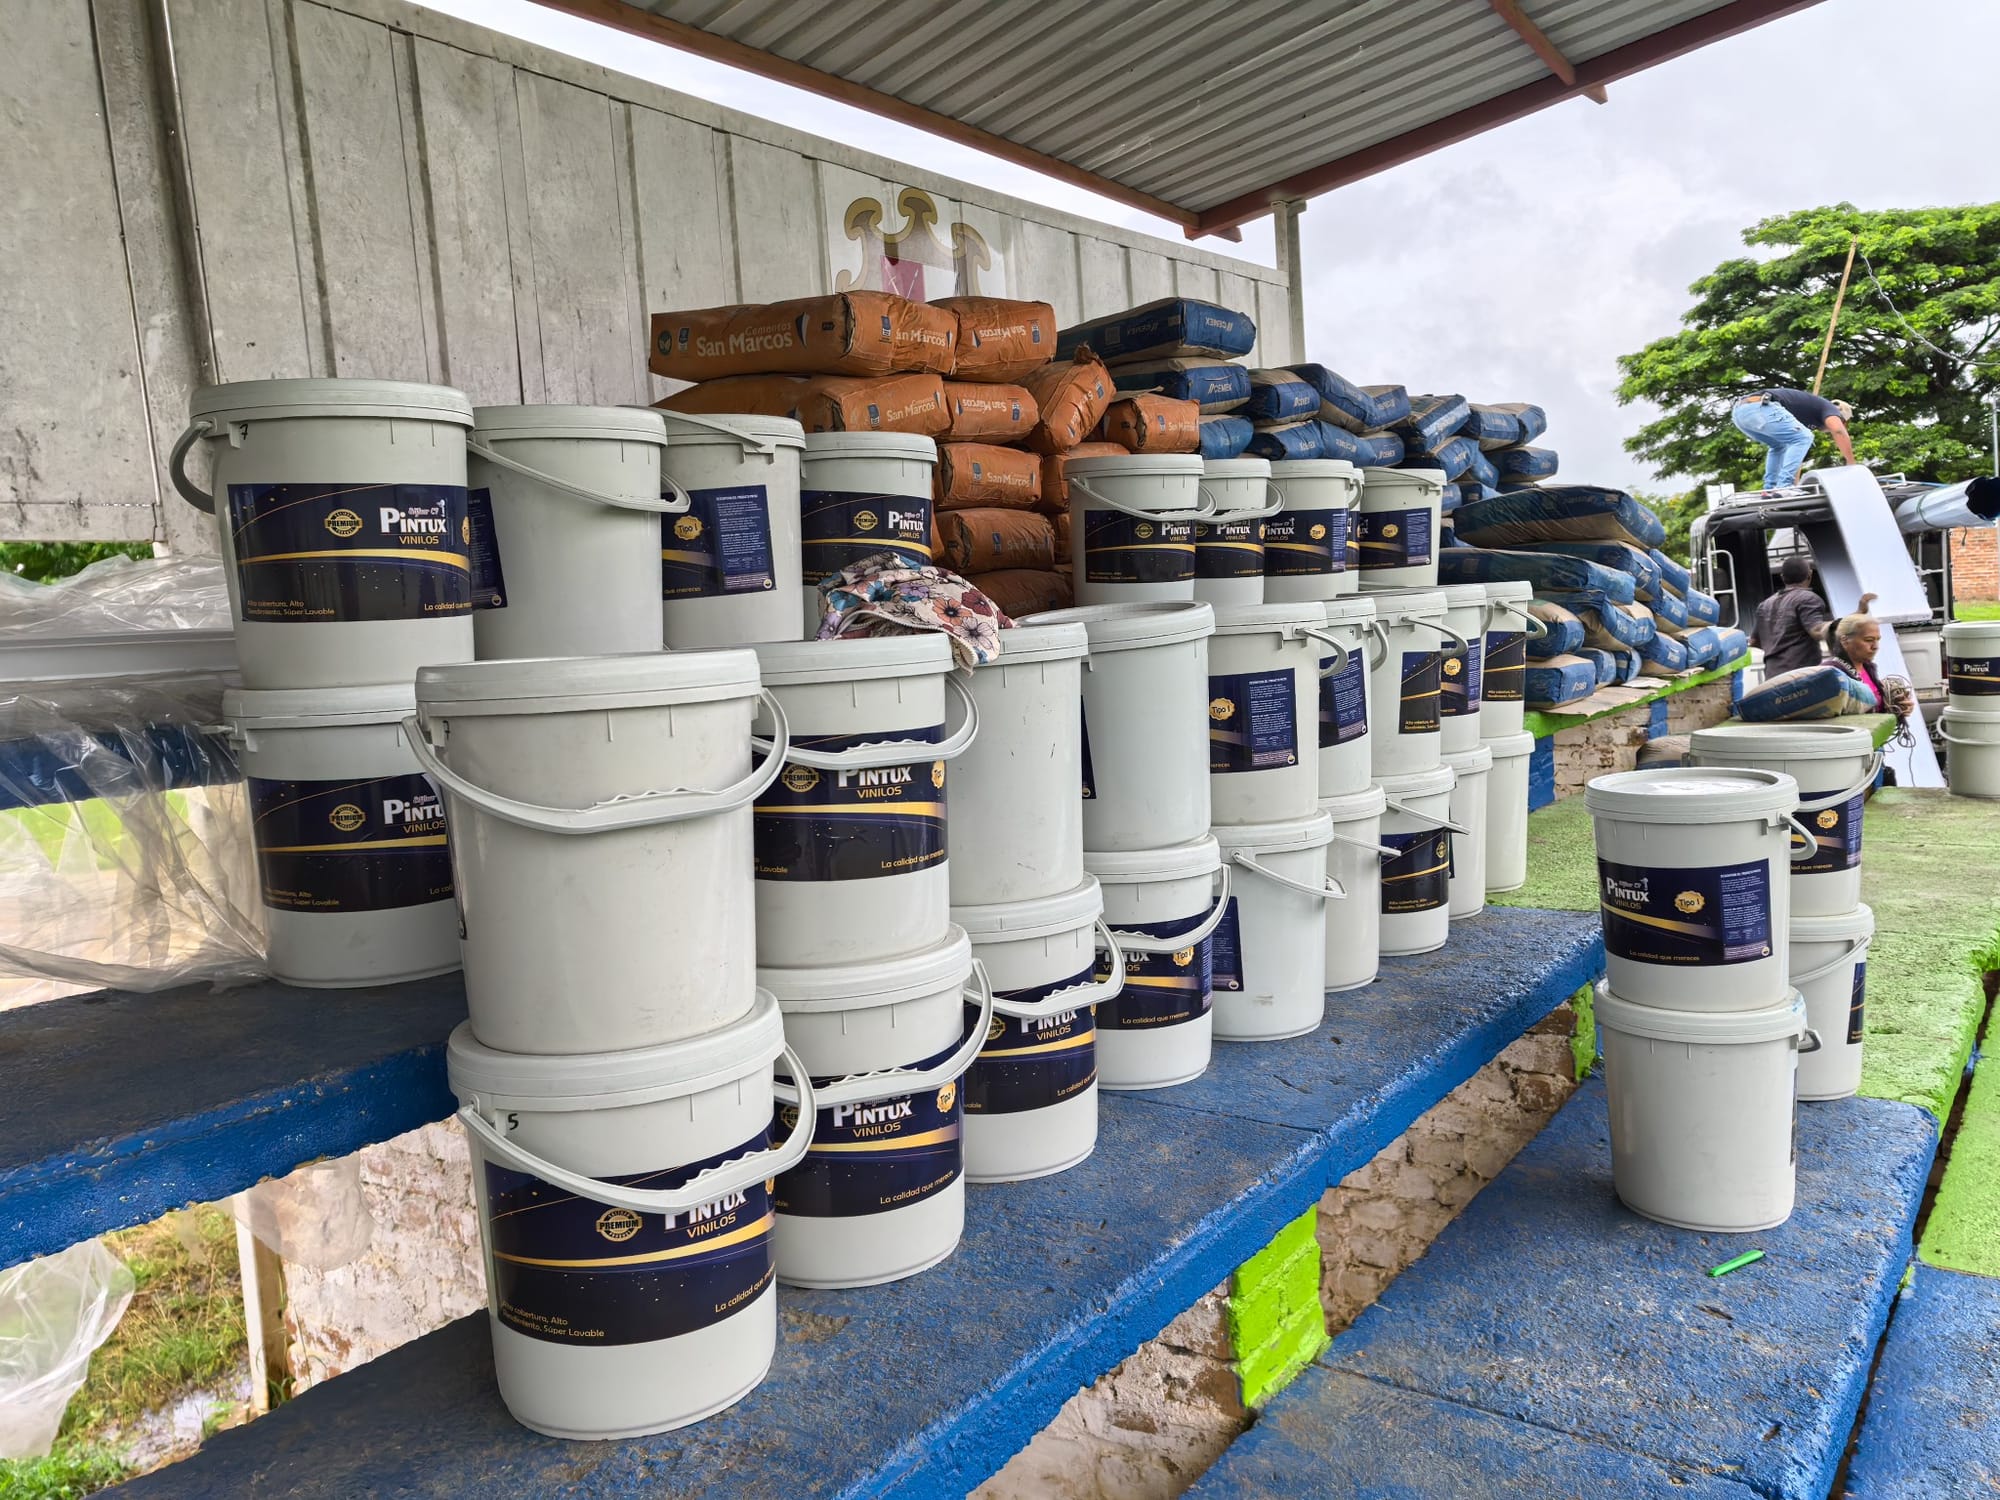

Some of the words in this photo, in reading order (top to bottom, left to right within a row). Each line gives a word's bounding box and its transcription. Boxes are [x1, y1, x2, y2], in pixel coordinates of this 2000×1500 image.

[745, 322, 792, 335] Cementos
[696, 337, 725, 357] San
[728, 332, 793, 355] Marcos
[910, 329, 946, 347] Marcos
[886, 409, 903, 421] San
[904, 401, 935, 417] Marcos
[240, 423, 248, 440] 7
[987, 472, 1001, 483] San
[399, 535, 439, 545] VINILOS
[424, 603, 433, 611] La
[1212, 706, 1227, 715] Tipo
[784, 774, 817, 782] PREMIUM
[856, 786, 902, 799] VINILOS
[881, 860, 892, 869] La
[893, 856, 918, 867] calidad
[1680, 898, 1695, 907] Tipo
[1036, 1025, 1072, 1041] VINILOS
[507, 1113, 519, 1131] 5
[853, 1121, 901, 1138] VINILOS
[880, 1197, 891, 1205] La
[892, 1187, 920, 1202] calidad
[921, 1182, 934, 1192] que
[599, 1220, 639, 1230] PREMIUM
[687, 1211, 736, 1239] VINILOS
[715, 1303, 727, 1313] La
[728, 1284, 753, 1307] calidad
[551, 1316, 568, 1326] Alto
[543, 1324, 566, 1335] Súper
[568, 1328, 605, 1337] Lavable
